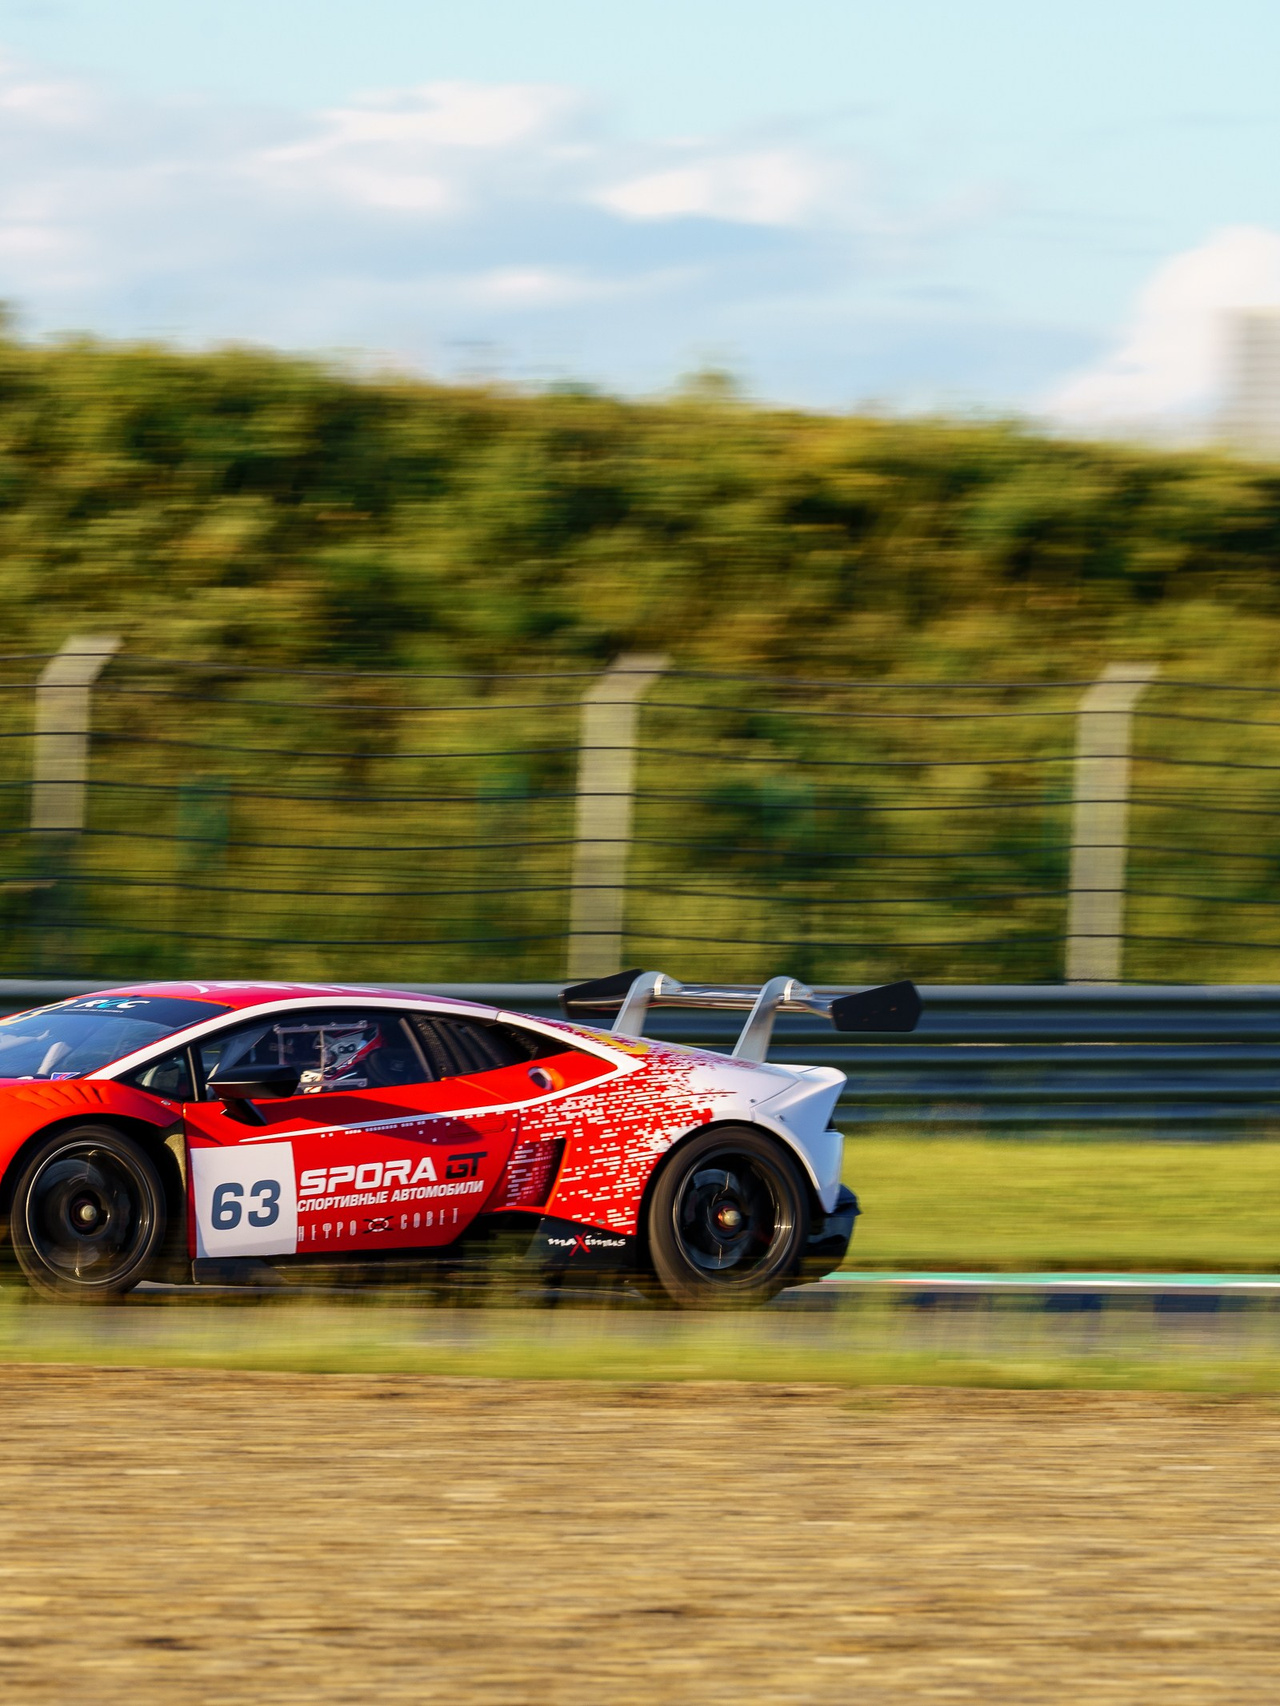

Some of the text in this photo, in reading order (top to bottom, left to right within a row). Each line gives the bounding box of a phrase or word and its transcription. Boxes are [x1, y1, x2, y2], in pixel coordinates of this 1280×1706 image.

[298, 1151, 488, 1196] SPORA GT
[210, 1179, 282, 1231] 63
[297, 1180, 485, 1213] СПОРТИВНЫЕ АВТОМОБИЛИ
[297, 1207, 460, 1242] НЕФРО СОВЕТ
